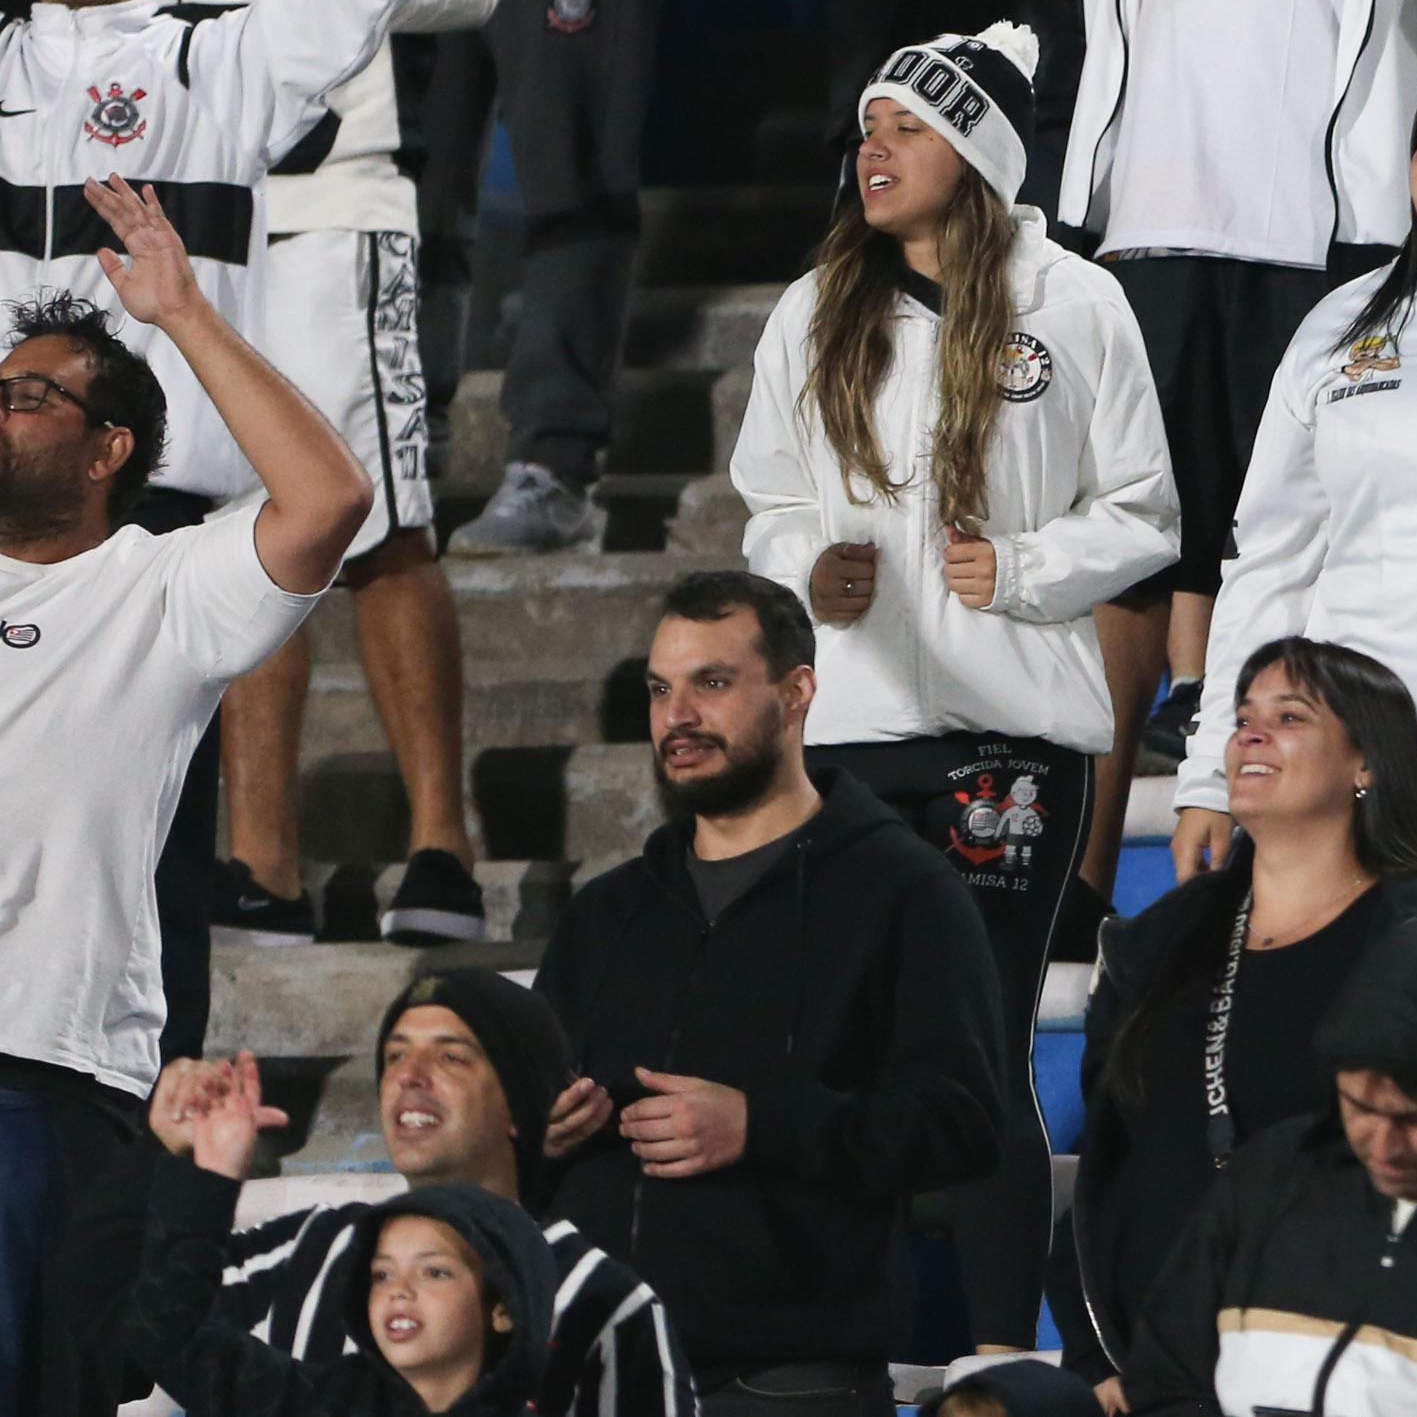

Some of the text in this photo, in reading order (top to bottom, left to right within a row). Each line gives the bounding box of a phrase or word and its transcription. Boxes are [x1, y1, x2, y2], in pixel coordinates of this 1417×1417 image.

[872, 49, 990, 138] DOR
[978, 744, 1012, 756] FIEL
[948, 759, 1050, 780] TORCIDA JOVEM
[1013, 878, 1028, 891] 12
